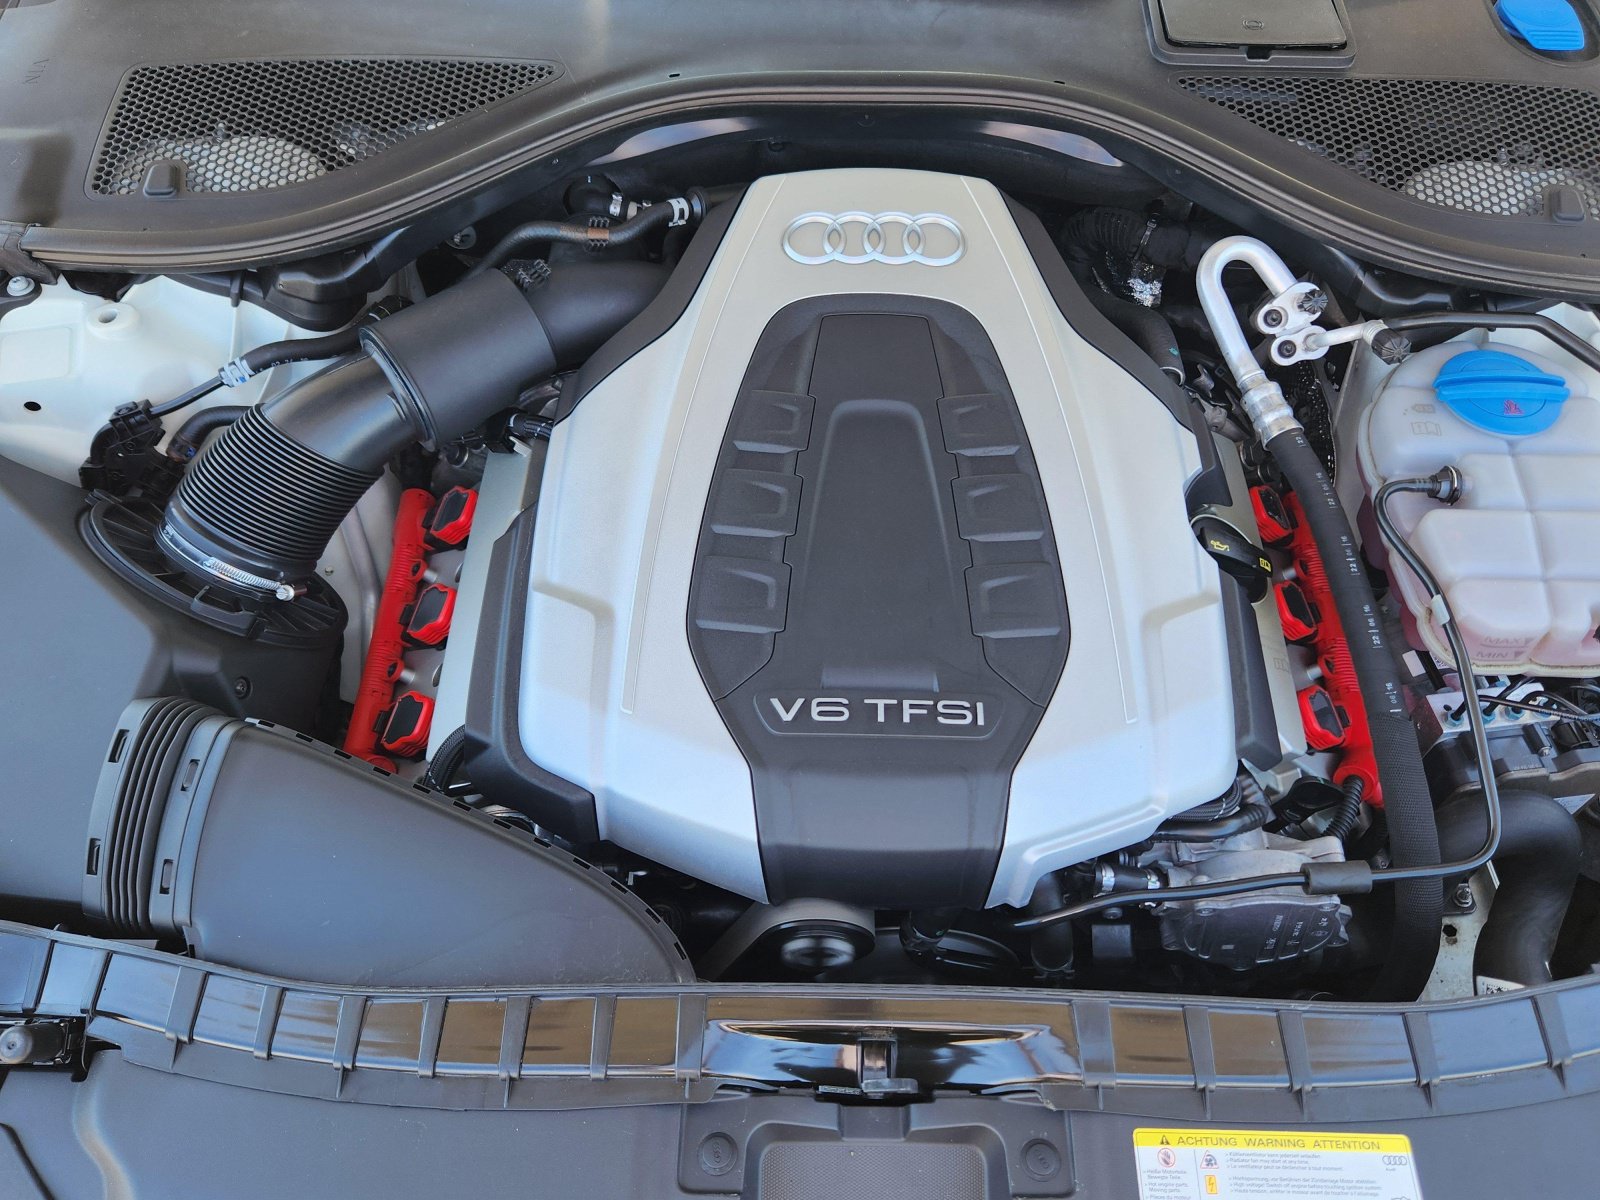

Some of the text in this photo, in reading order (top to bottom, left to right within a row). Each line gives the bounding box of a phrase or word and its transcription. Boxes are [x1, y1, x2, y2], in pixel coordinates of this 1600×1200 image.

[770, 697, 985, 726] V6 TFSI
[1177, 1136, 1381, 1150] ACHTUNG WARNING ATTENTION
